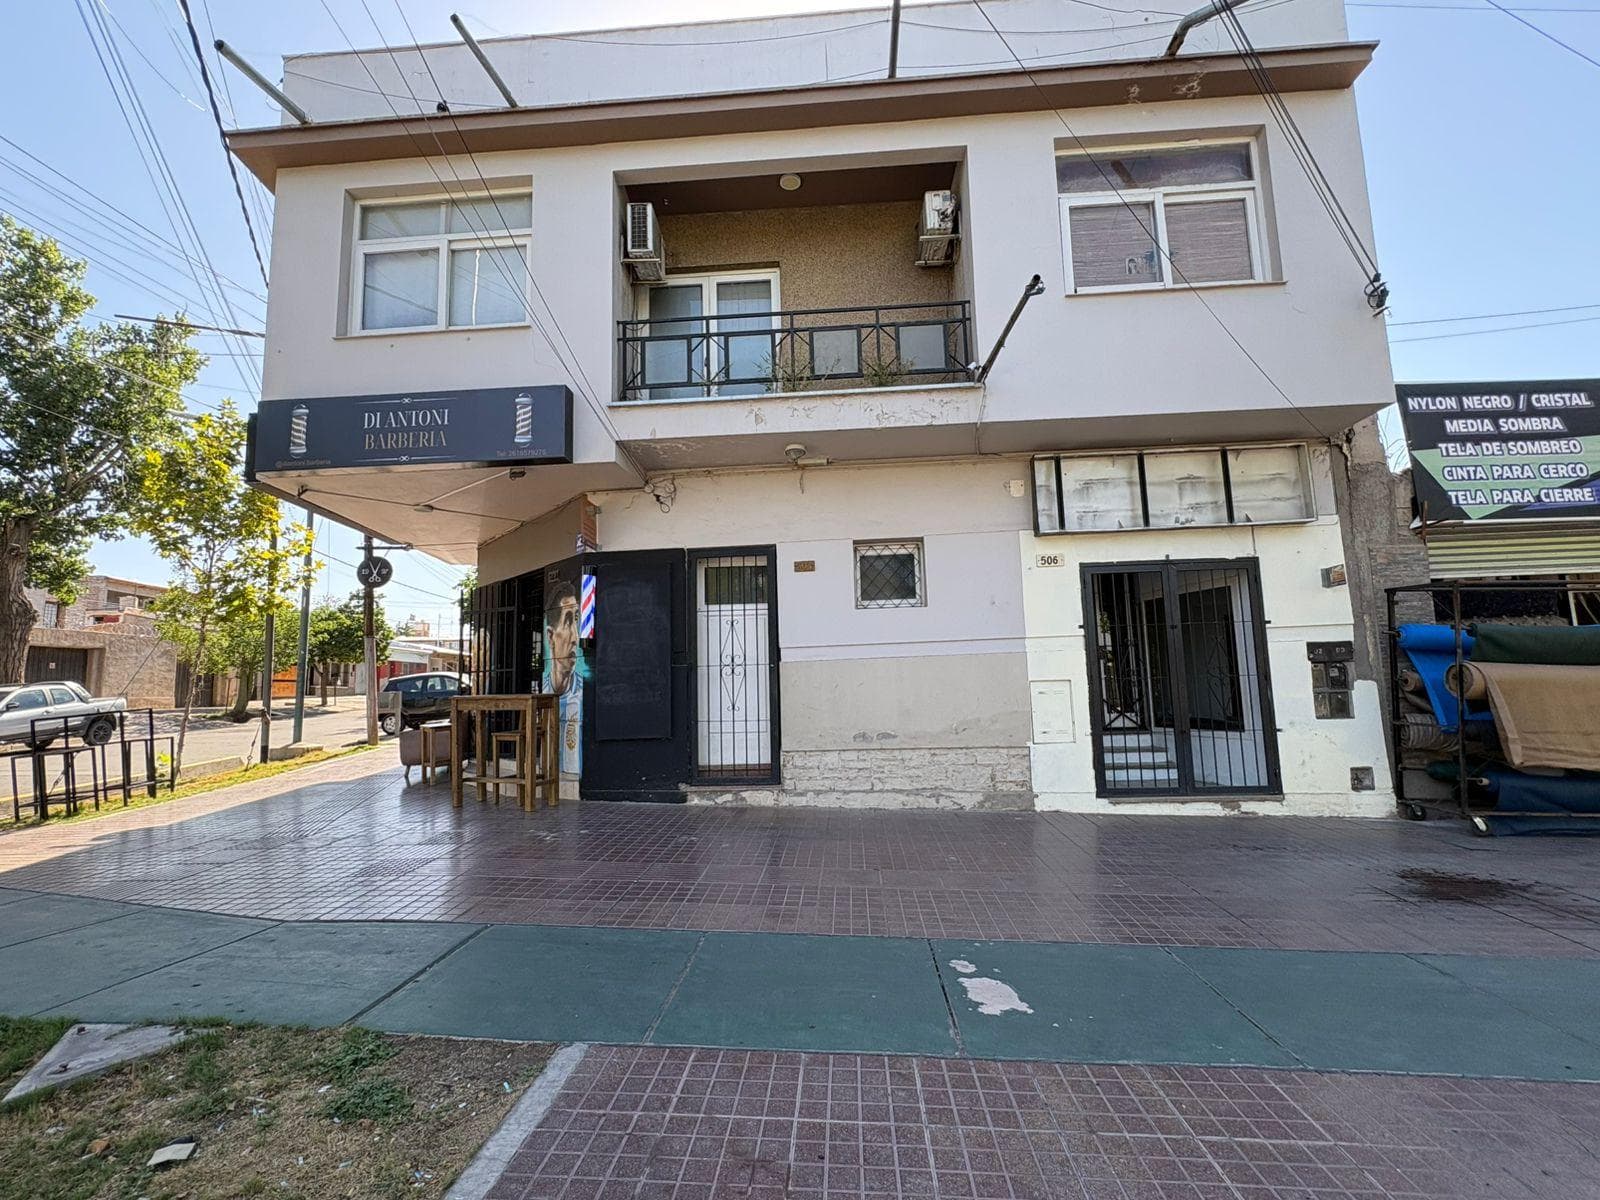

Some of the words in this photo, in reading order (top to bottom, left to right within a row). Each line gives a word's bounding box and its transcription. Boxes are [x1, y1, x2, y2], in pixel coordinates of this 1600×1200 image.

[1407, 396, 1458, 411] NYLON
[1463, 395, 1513, 410] NEGRO
[1518, 394, 1526, 410] /
[1531, 393, 1592, 408] CRISTAL
[363, 412, 381, 429] DI
[384, 408, 449, 428] ANTONI
[1445, 419, 1495, 433] MEDIA
[1499, 417, 1565, 432] SOMBRA
[364, 430, 447, 450] BARBERIA
[1438, 442, 1478, 457] TELA
[1481, 441, 1503, 456] DE
[1507, 439, 1582, 455] SOMBREO
[1443, 465, 1488, 481] CINTA
[1492, 464, 1536, 480] PARA
[1539, 463, 1589, 479] CERCO
[1447, 489, 1488, 505] TELA
[1492, 488, 1536, 504] PARA
[1540, 487, 1594, 503] CIERRE
[1040, 555, 1059, 566] 506
